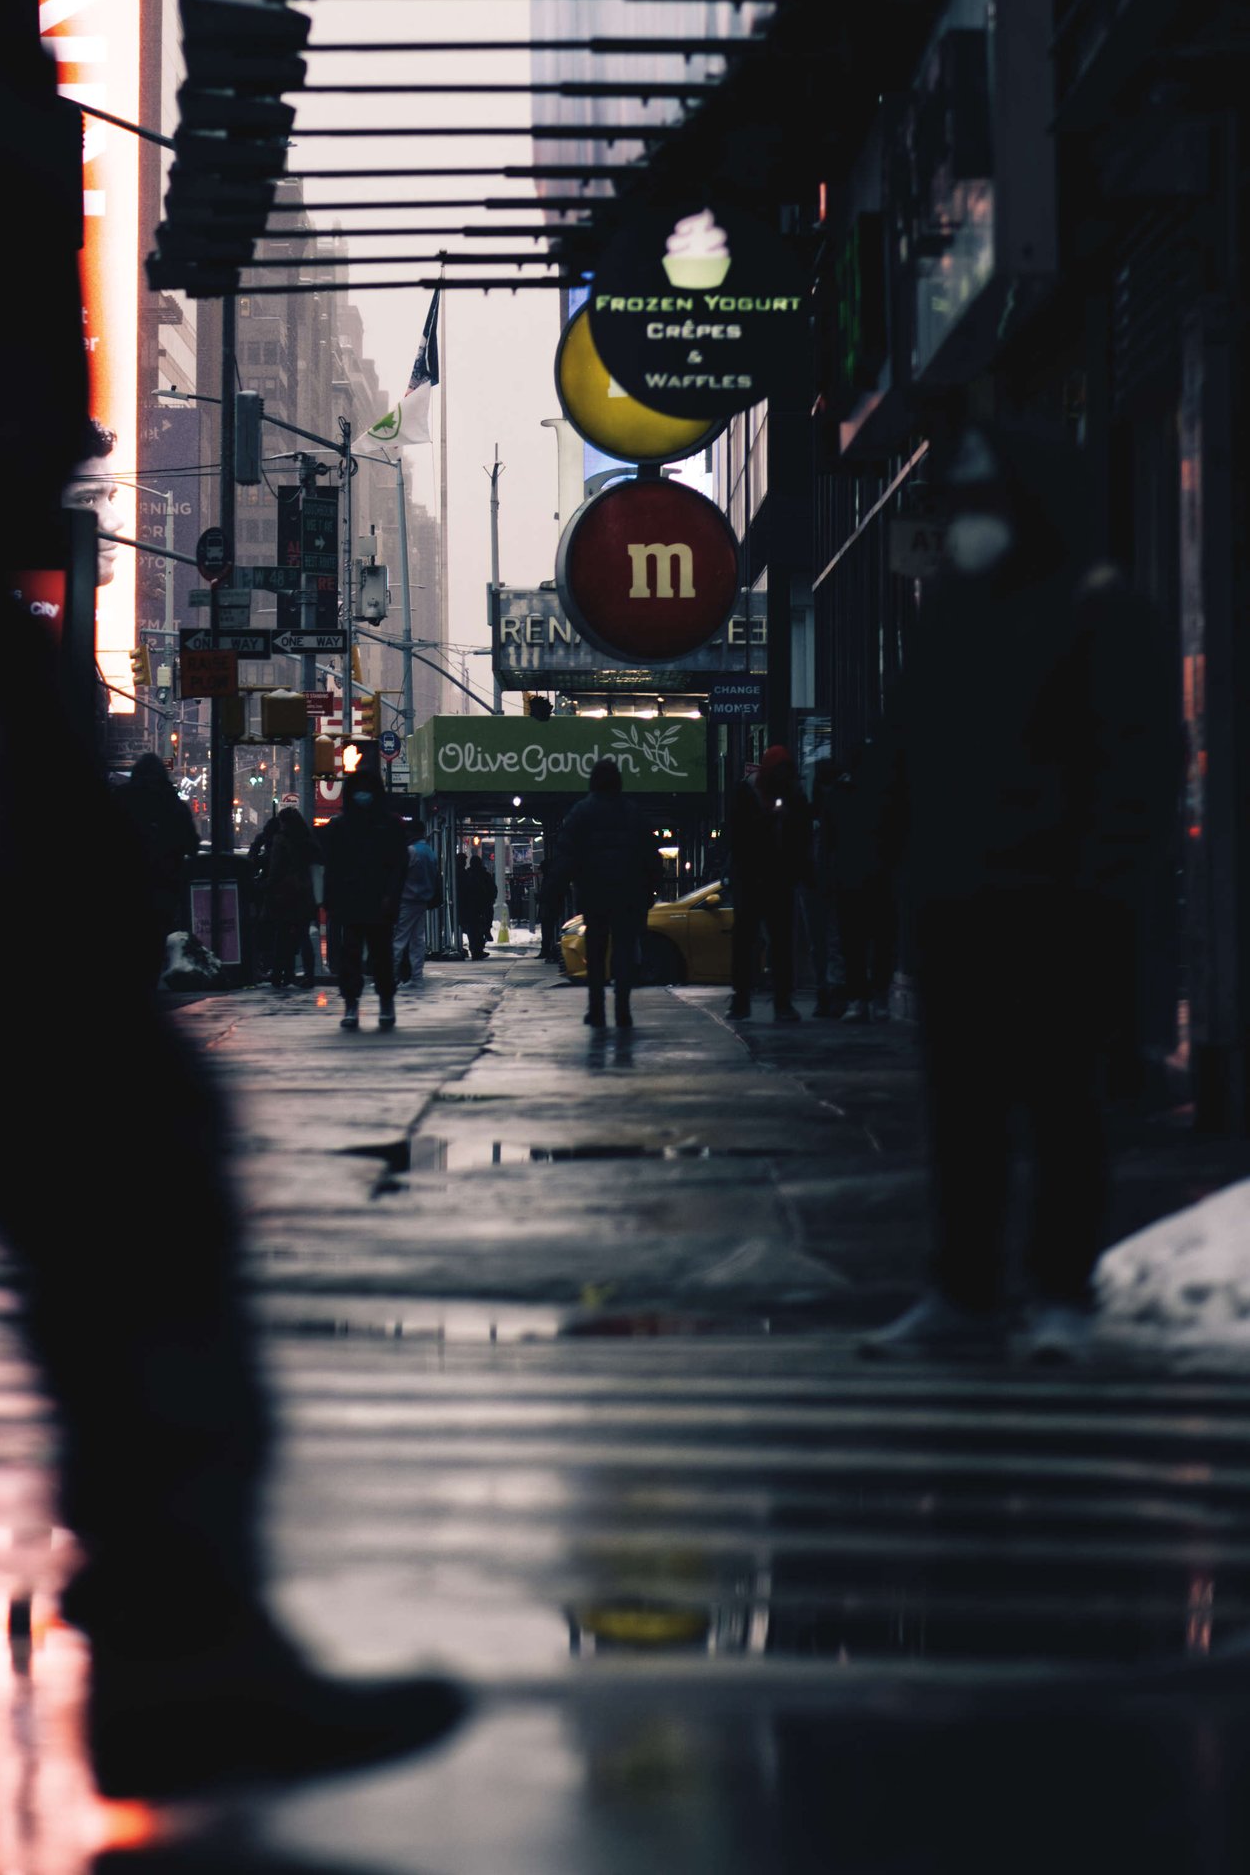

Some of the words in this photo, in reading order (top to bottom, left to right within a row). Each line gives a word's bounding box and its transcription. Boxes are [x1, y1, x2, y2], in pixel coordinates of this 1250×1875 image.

[596, 295, 693, 312] FROZEN
[703, 294, 801, 312] YOGURT
[687, 349, 703, 364] &
[645, 373, 752, 389] WAFFLES
[627, 542, 696, 598] m
[269, 570, 285, 587] 48
[230, 637, 259, 651] WAY
[281, 636, 305, 648] ONE
[316, 636, 341, 648] WAY
[713, 685, 761, 695] CHANGE
[713, 703, 760, 714] MONEY
